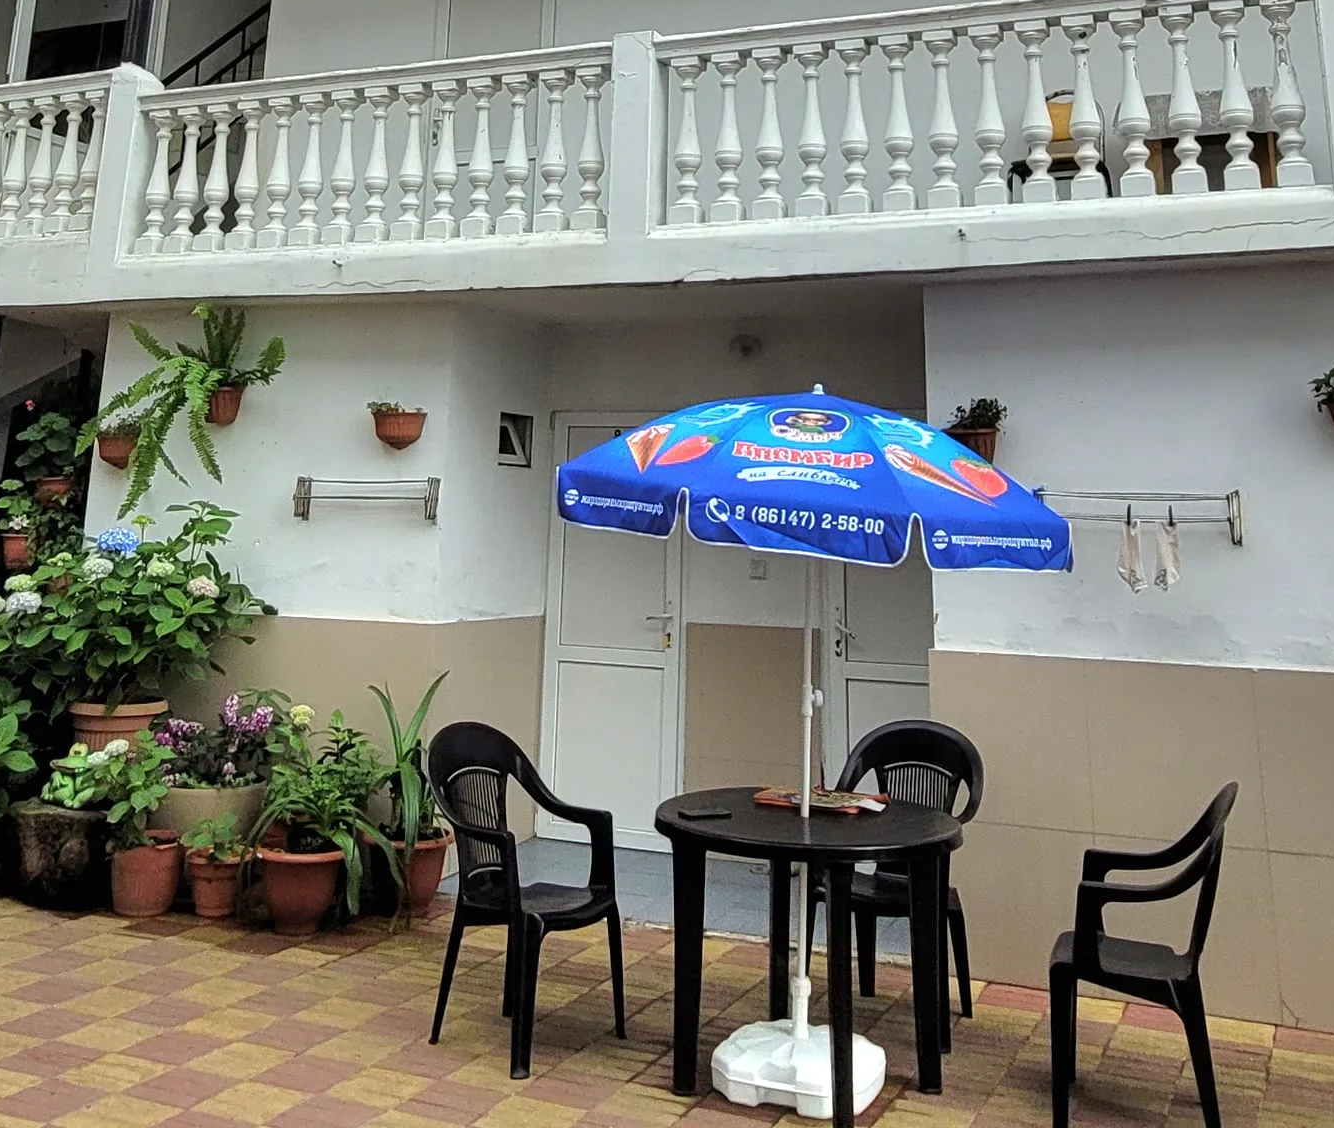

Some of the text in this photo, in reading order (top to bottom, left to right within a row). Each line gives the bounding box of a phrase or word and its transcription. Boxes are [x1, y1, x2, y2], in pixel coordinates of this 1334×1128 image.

[734, 505, 885, 535] 8 (86147) 2-58-00
